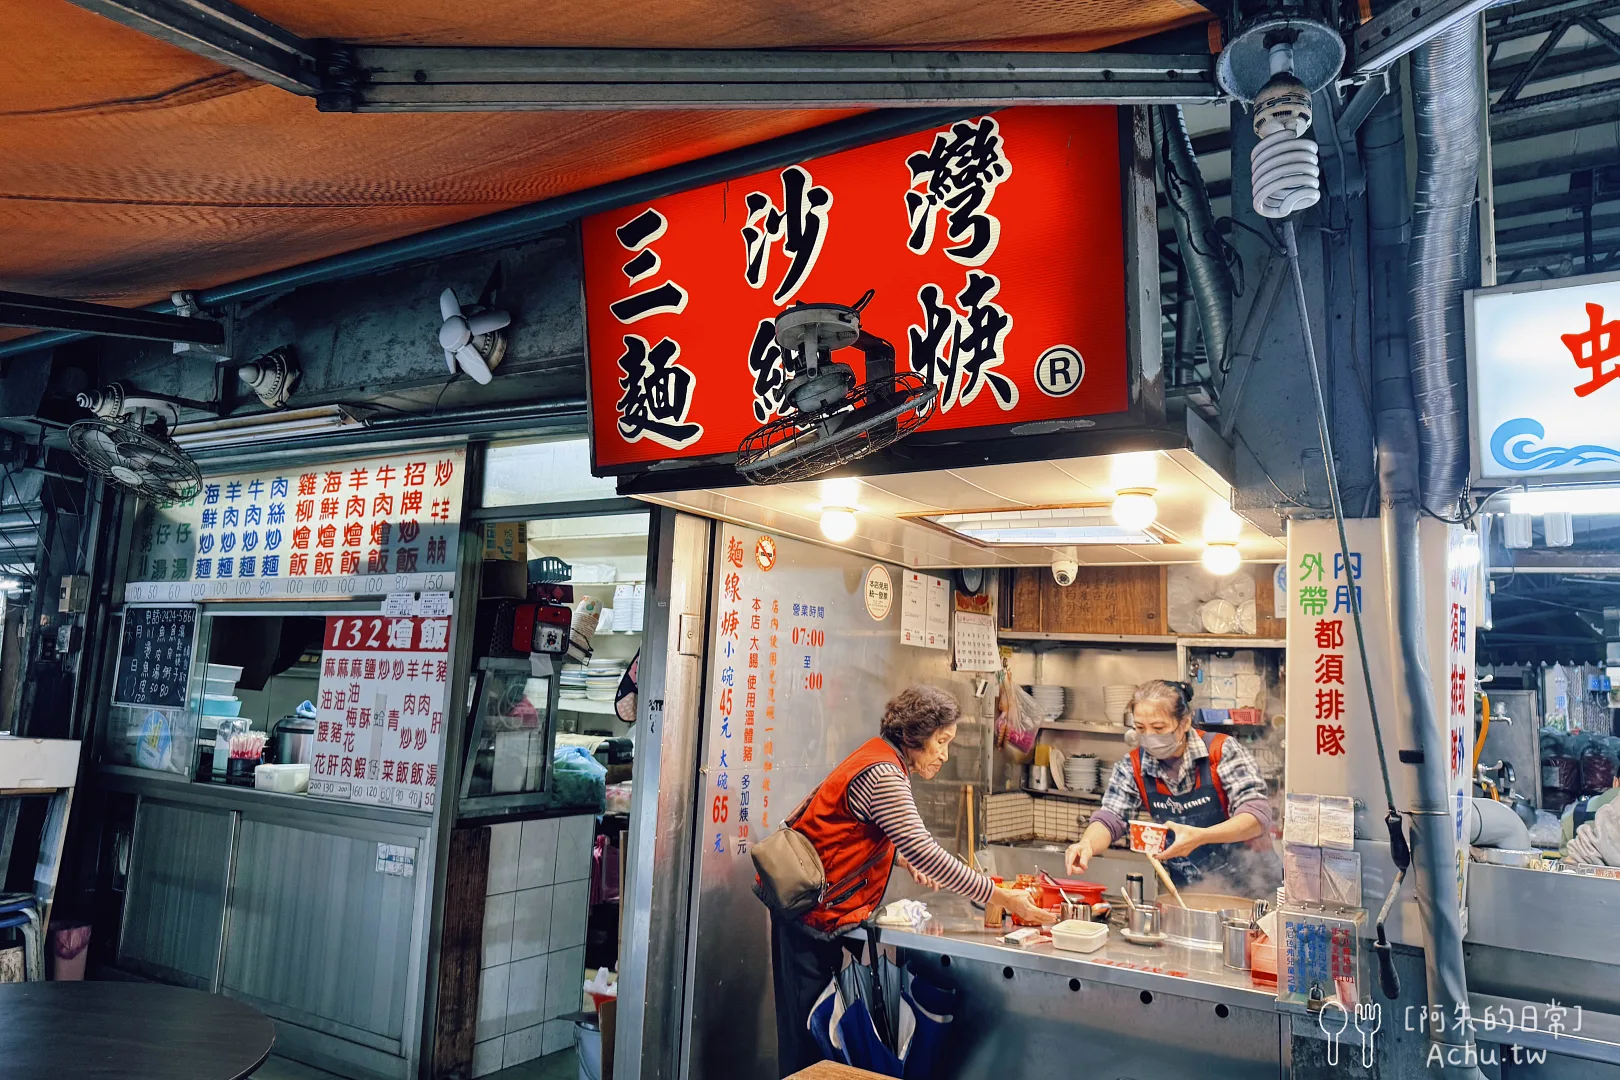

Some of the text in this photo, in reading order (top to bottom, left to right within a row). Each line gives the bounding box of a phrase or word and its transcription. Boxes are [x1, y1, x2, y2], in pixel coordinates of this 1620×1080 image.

[195, 484, 220, 579] 海鮮炒麵
[216, 481, 242, 579] 羊肉炒麵
[239, 479, 264, 578] 牛肉炒麵
[261, 476, 288, 577] 肉絲炒麵
[289, 472, 317, 576] 雞柳燴飯
[314, 470, 342, 575] 海鮮燴飯
[341, 467, 368, 574] 羊肉燴飯
[368, 465, 396, 573] 牛肉燴飯
[396, 462, 426, 573] 招牌炒飯
[148, 585, 158, 599] 50
[169, 585, 180, 599] 60
[190, 584, 205, 596] 100
[213, 583, 227, 595] 100
[235, 581, 250, 595] 100
[260, 582, 270, 595] 80
[286, 580, 303, 593] 100
[313, 580, 328, 593] 100
[338, 578, 355, 593] 100
[365, 578, 383, 592] 100
[395, 576, 408, 589] 80
[424, 575, 443, 590] 150
[721, 536, 744, 640] 麵線焿
[793, 603, 824, 618] 營業時間
[1299, 551, 1328, 616] 外帶
[1333, 551, 1362, 614] 內用
[792, 627, 824, 647] 07:00
[804, 656, 811, 668] 至
[1314, 619, 1346, 756] 都須排隊
[314, 657, 336, 774] 麻油腰花
[326, 658, 349, 776] 麻油豬肝
[340, 657, 363, 777] 麻油梅花肉
[354, 658, 376, 779] 鹽酥蝦
[382, 659, 404, 780] 炒青菜
[396, 659, 419, 783] 羊肉炒飯
[410, 659, 434, 785] 牛肉炒飯
[323, 782, 334, 792] 130
[352, 786, 363, 797] 160
[366, 786, 378, 797] 120
[381, 788, 391, 800] 60
[425, 792, 435, 805] 50
